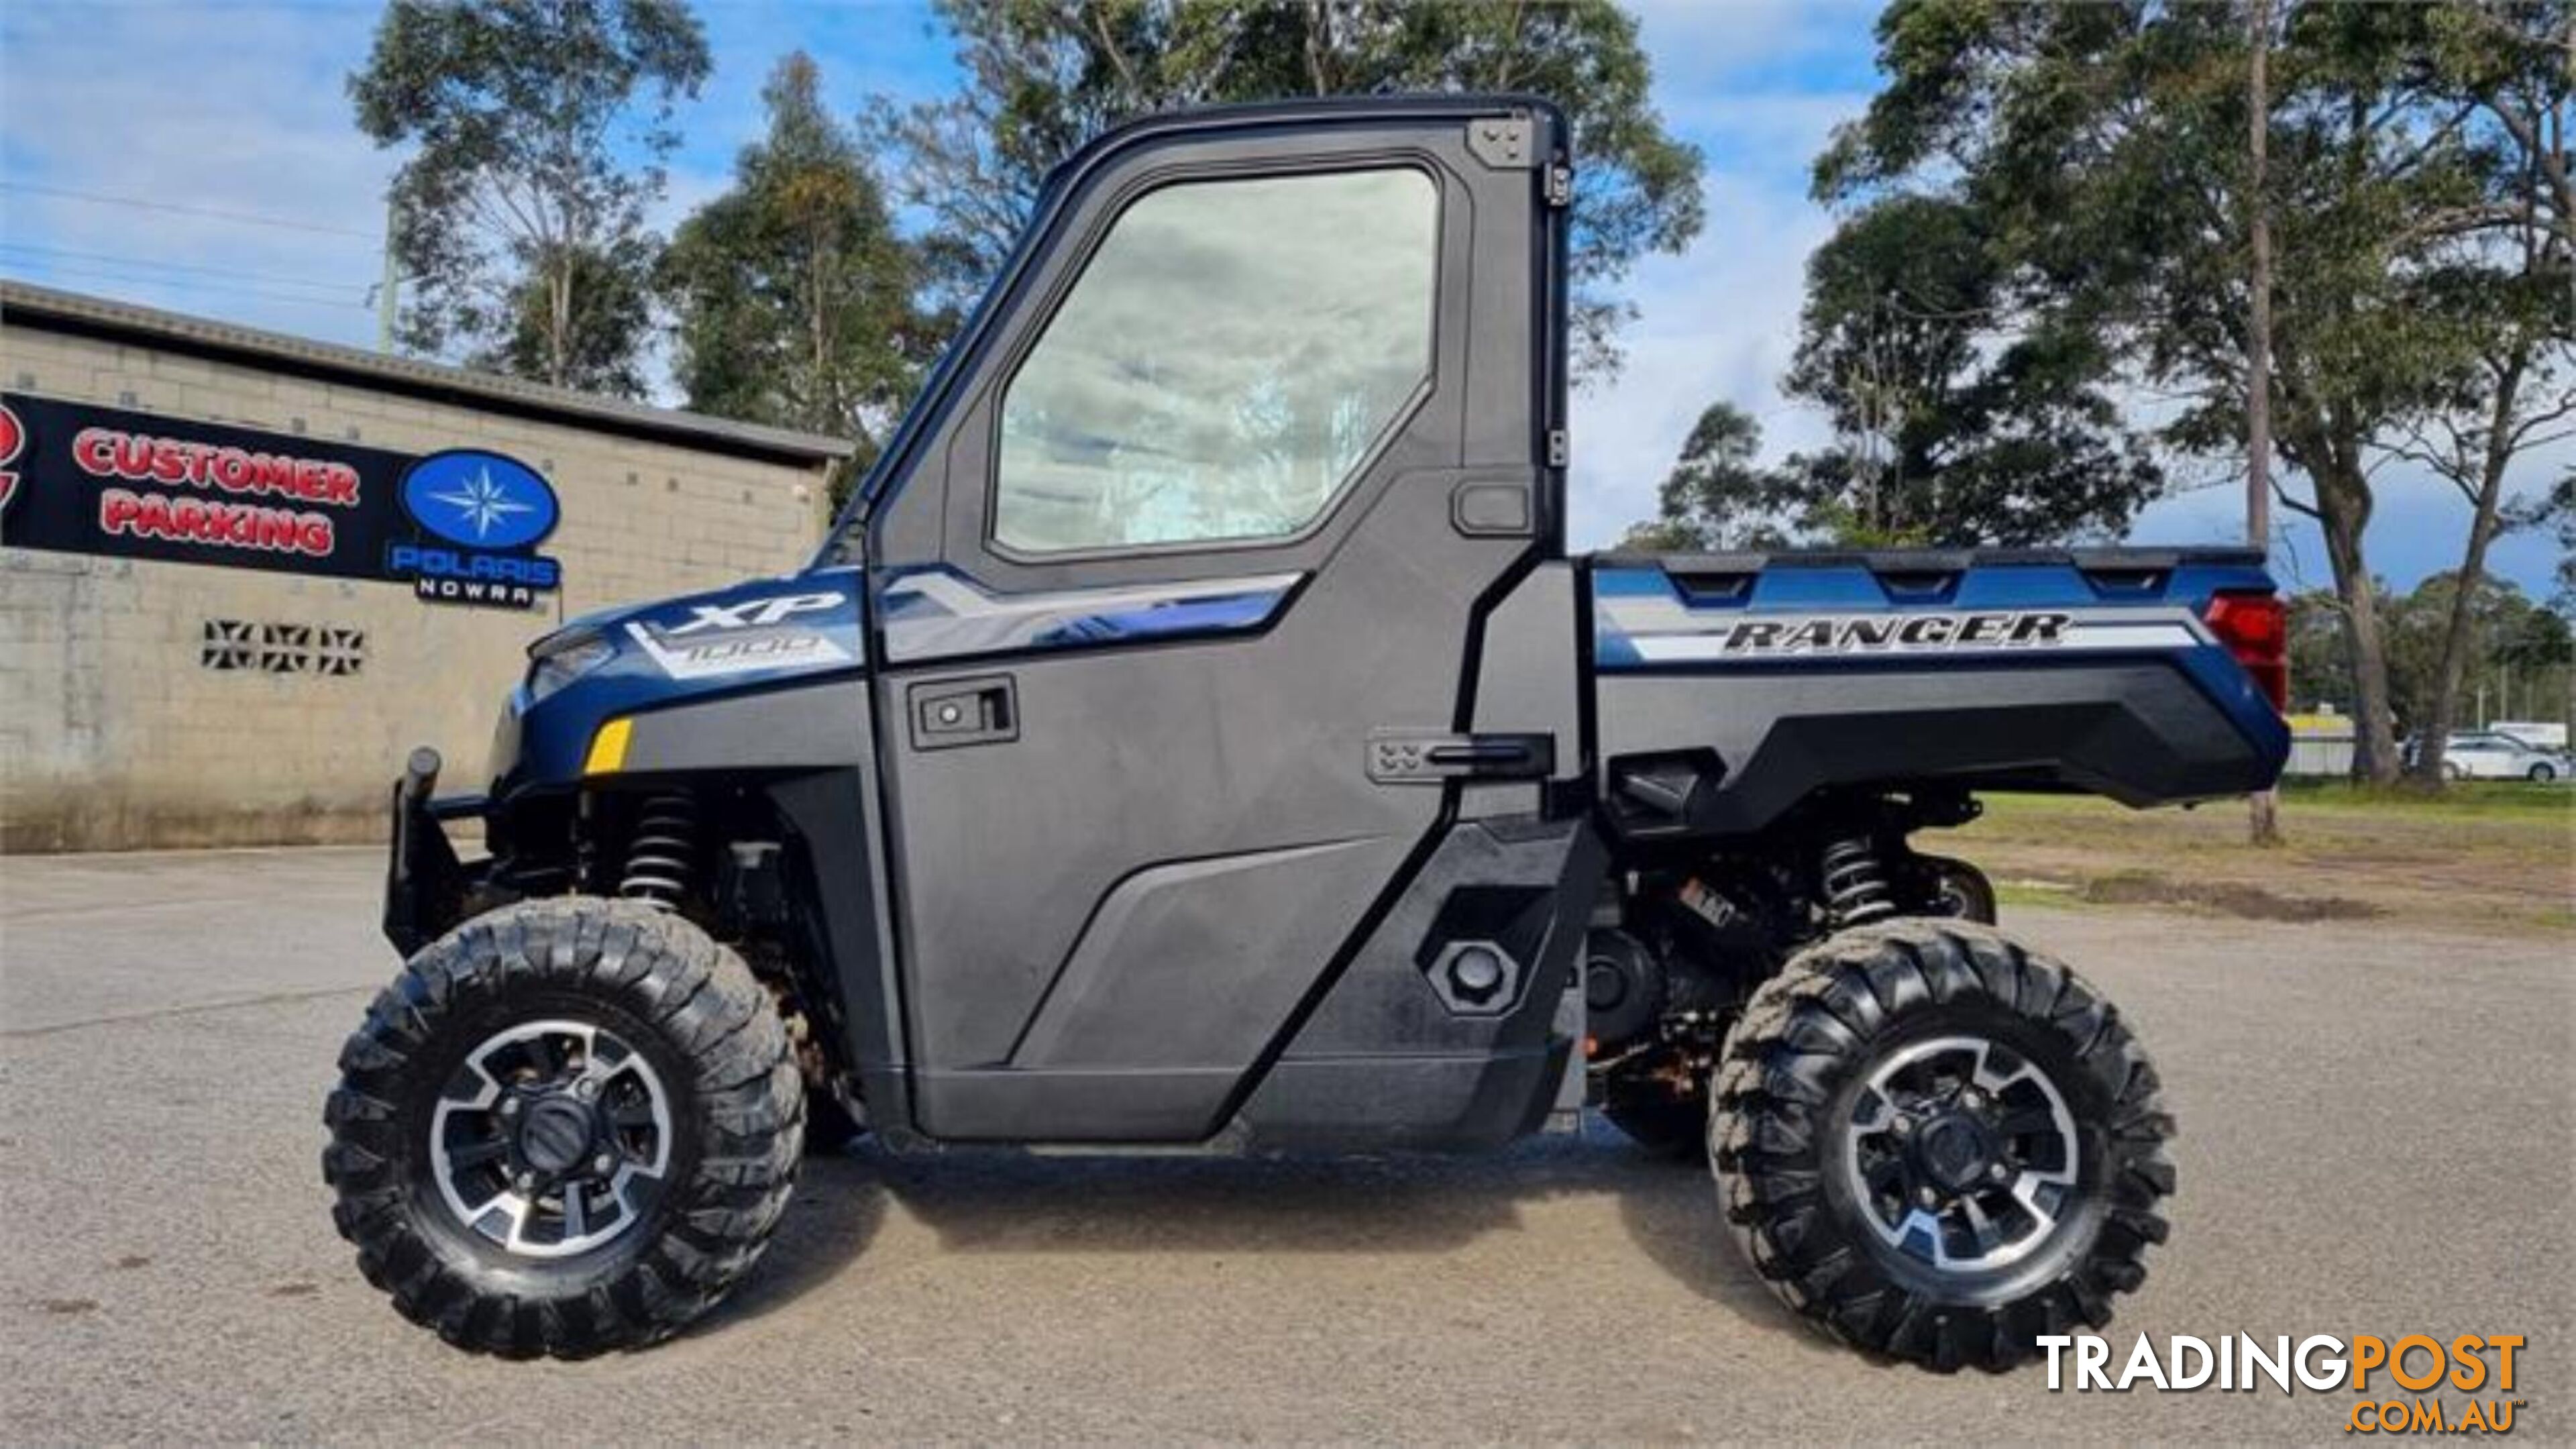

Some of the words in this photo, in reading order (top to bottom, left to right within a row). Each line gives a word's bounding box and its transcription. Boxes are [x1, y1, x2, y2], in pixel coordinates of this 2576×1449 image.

[75, 428, 360, 504] CUSTOMER
[102, 490, 334, 555] PARKING
[392, 546, 555, 585] POLARIS
[419, 578, 529, 602] NOWRA
[668, 591, 846, 634] XP
[1724, 612, 2072, 649] RANGER
[688, 636, 824, 661] 1000
